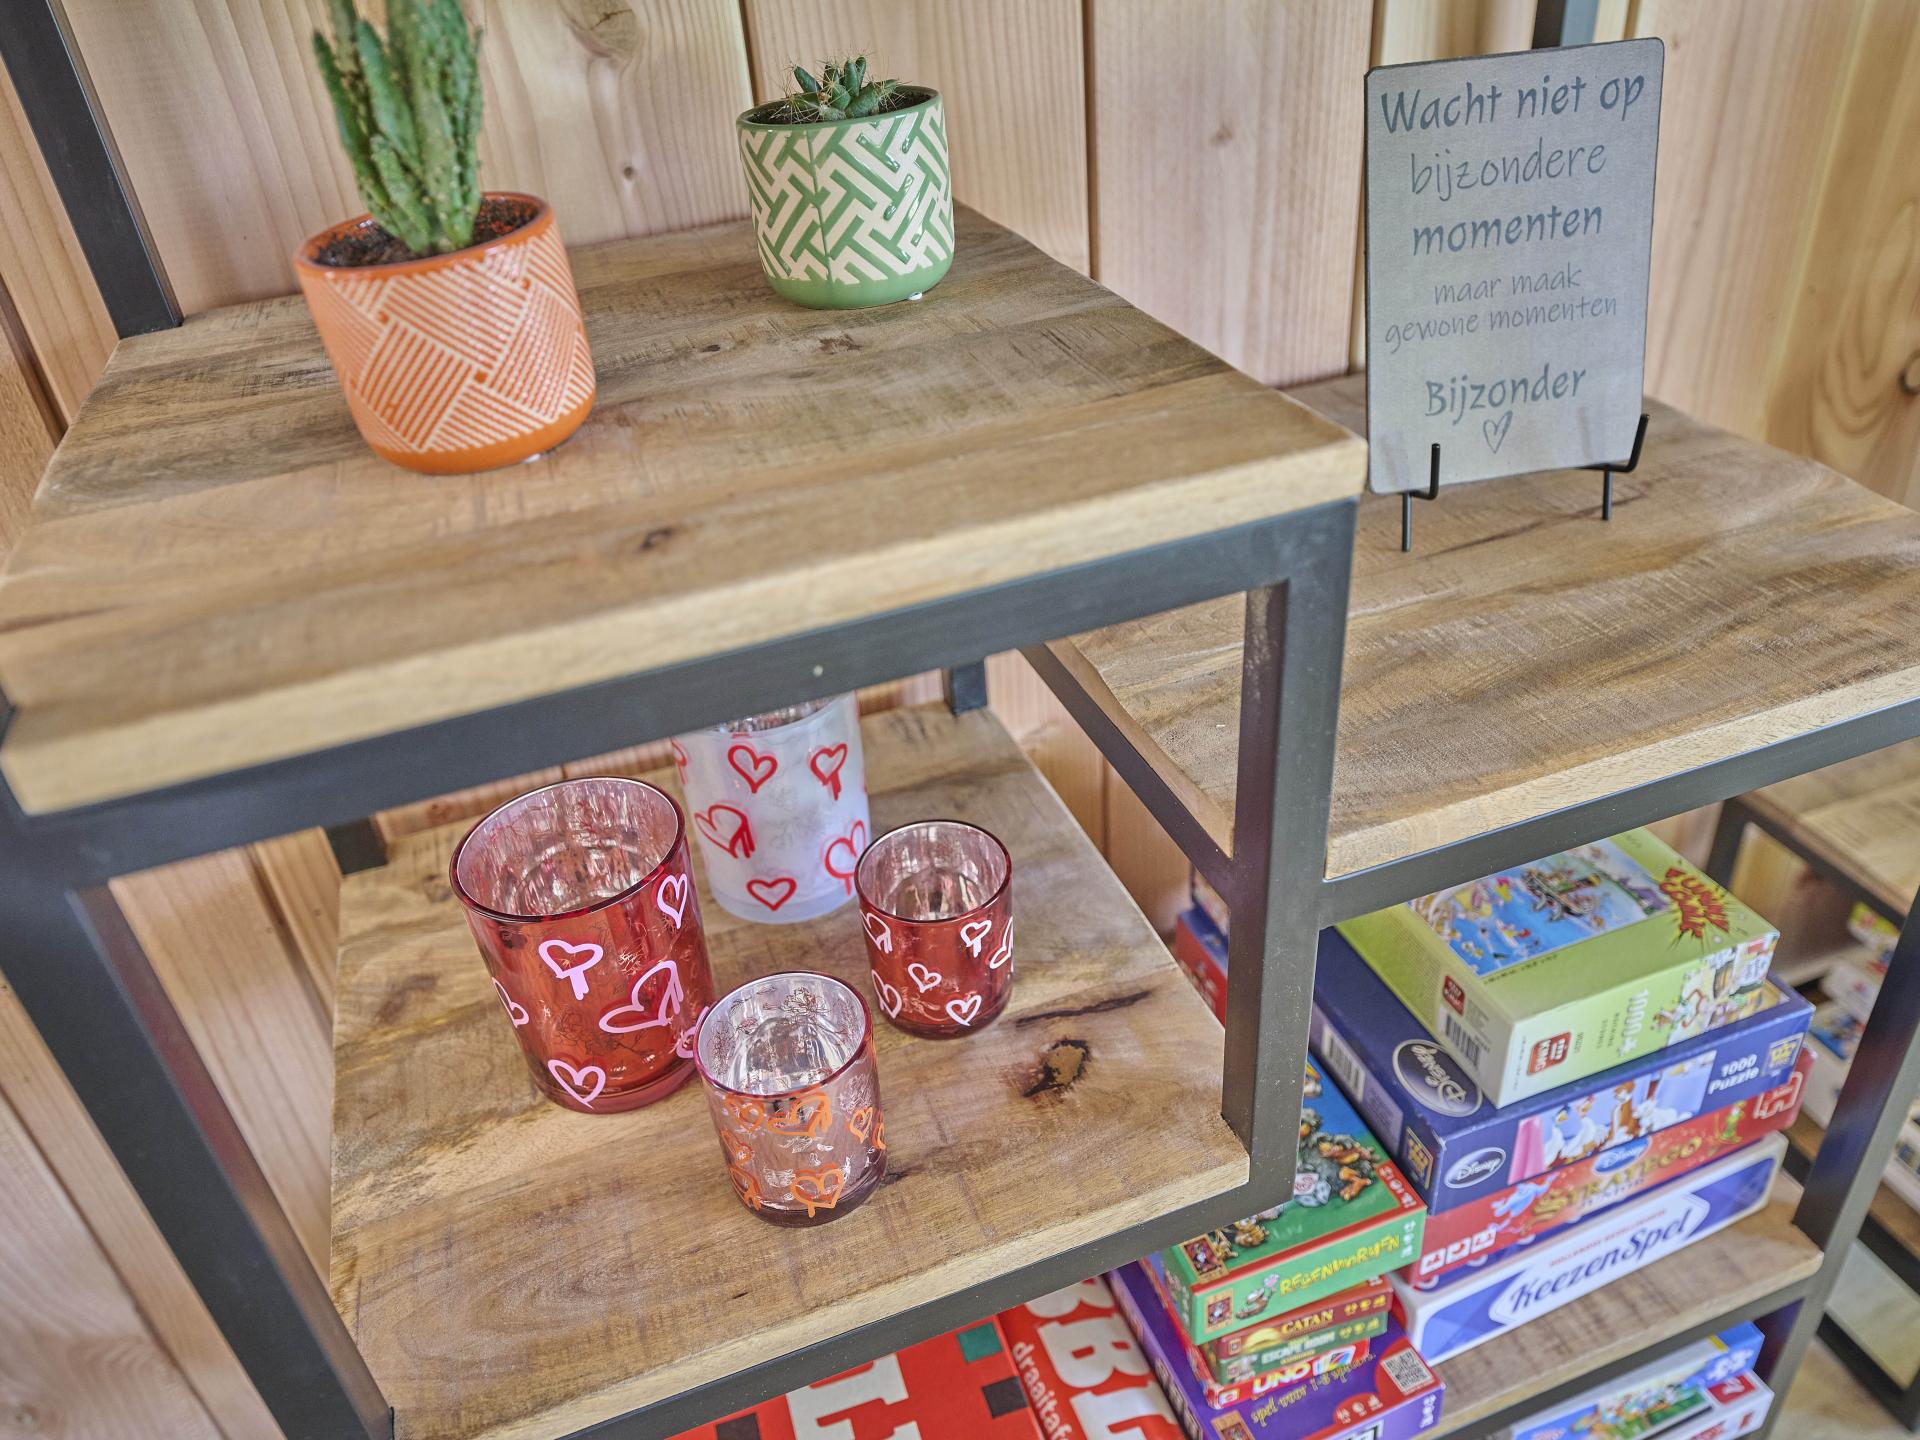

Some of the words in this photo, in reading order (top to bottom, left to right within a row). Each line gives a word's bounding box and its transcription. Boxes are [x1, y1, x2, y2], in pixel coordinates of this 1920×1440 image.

[1381, 81, 1503, 134] Wacht
[1517, 75, 1586, 118] niet
[1600, 75, 1645, 121] op
[1411, 136, 1607, 202] bijzondere
[1412, 205, 1603, 256] momenten
[1434, 276, 1502, 305] maar
[1512, 261, 1583, 295] maak
[1385, 311, 1478, 354] gewone
[1490, 294, 1617, 332] momenten
[1425, 363, 1586, 426] Bijzonder
[1411, 1044, 1467, 1104] Disney
[1707, 1066, 1760, 1095] Puzzle
[1721, 1053, 1758, 1078] 1000
[1454, 1156, 1501, 1182] Disney
[1279, 1233, 1400, 1297] REGENWORMEN
[1509, 1208, 1692, 1314] KeezenSpel
[1281, 1309, 1334, 1335] CATAN
[1012, 1341, 1074, 1440] draaitaf
[1252, 1362, 1312, 1394] UNO
